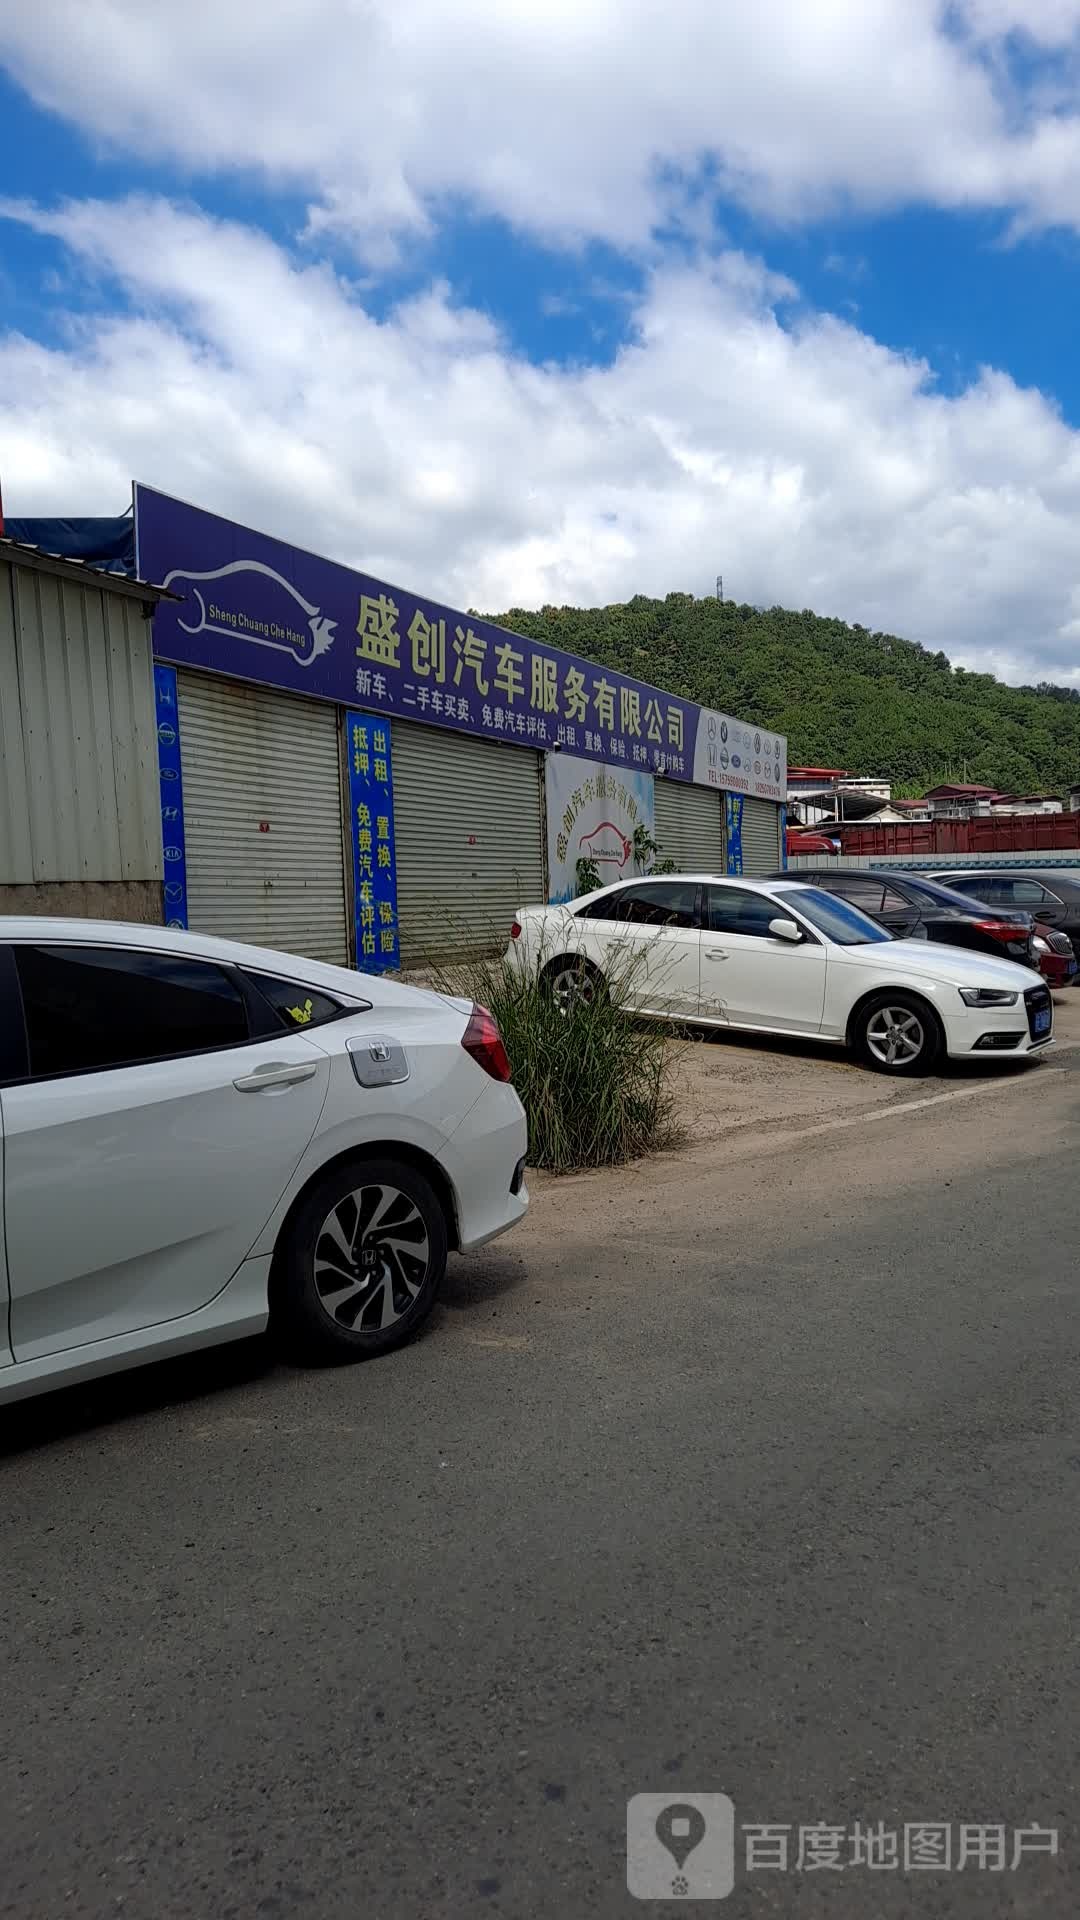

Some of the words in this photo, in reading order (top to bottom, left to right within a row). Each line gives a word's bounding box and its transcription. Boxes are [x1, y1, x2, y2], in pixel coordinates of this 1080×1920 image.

[209, 604, 237, 626] Sheng
[238, 613, 269, 636] Chuang
[270, 624, 285, 639] Che
[286, 629, 305, 647] Hang
[356, 594, 684, 751] 盛创汽车服务有限公司
